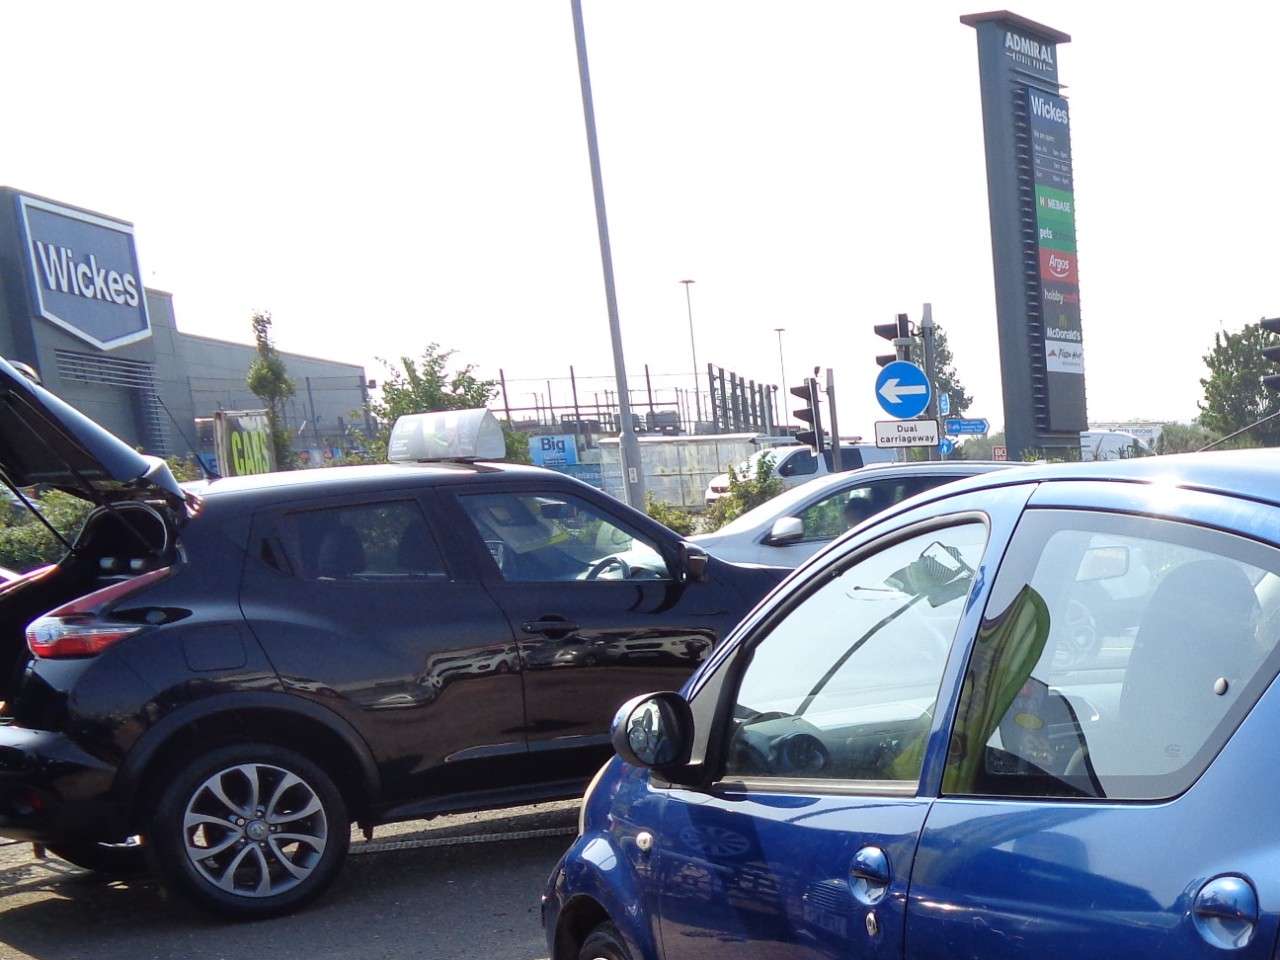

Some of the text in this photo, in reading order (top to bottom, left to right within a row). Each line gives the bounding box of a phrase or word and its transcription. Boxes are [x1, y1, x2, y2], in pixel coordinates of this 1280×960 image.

[1004, 31, 1053, 64] ADMIRAL
[1030, 95, 1068, 124] Wickes
[1048, 254, 1070, 271] Argos
[35, 240, 140, 307] Wickes
[1046, 327, 1081, 341] McDonald's
[896, 424, 918, 433] Dual
[541, 436, 566, 454] Big
[880, 435, 935, 445] carriageway
